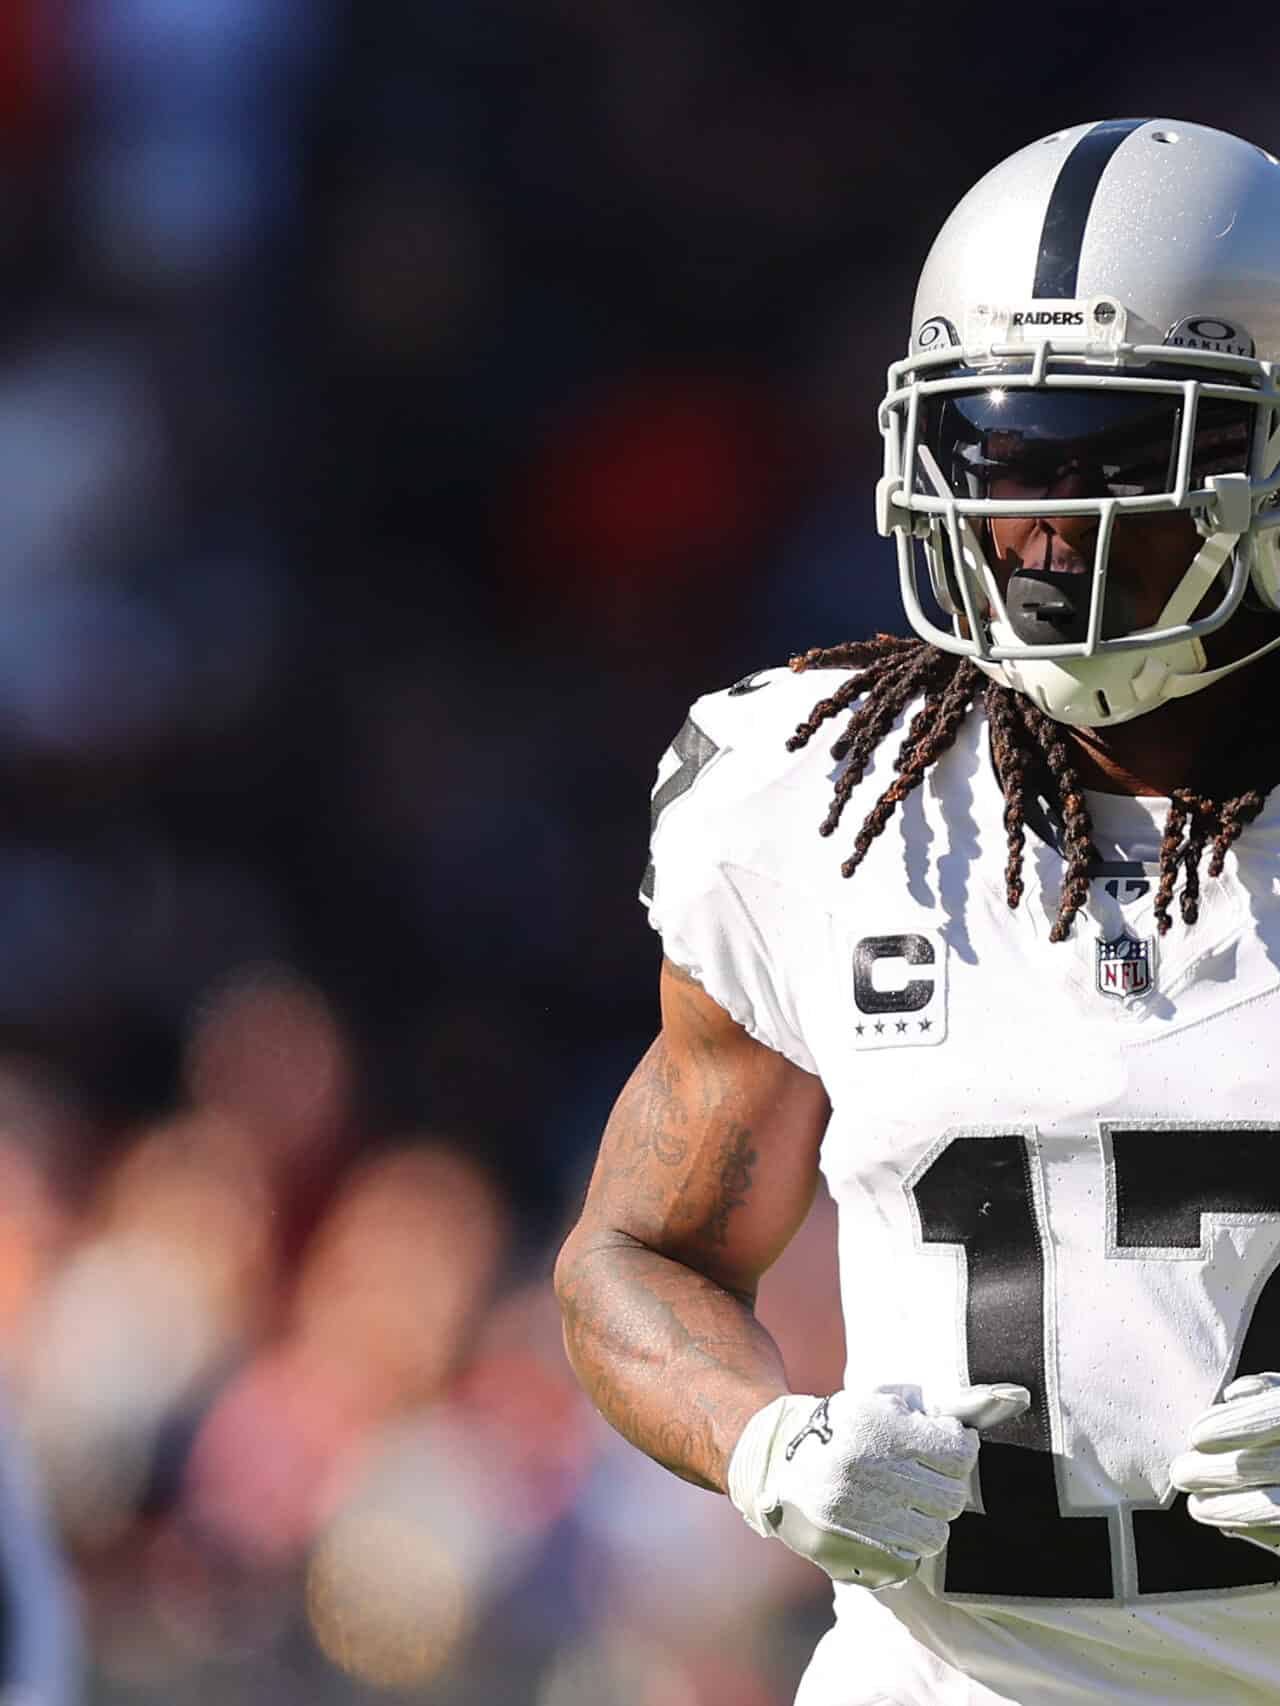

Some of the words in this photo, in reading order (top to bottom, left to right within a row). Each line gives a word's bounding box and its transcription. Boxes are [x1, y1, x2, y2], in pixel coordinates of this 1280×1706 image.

[1013, 311, 1084, 326] RAIDERS
[852, 932, 936, 1015] C
[1103, 961, 1145, 990] NFL
